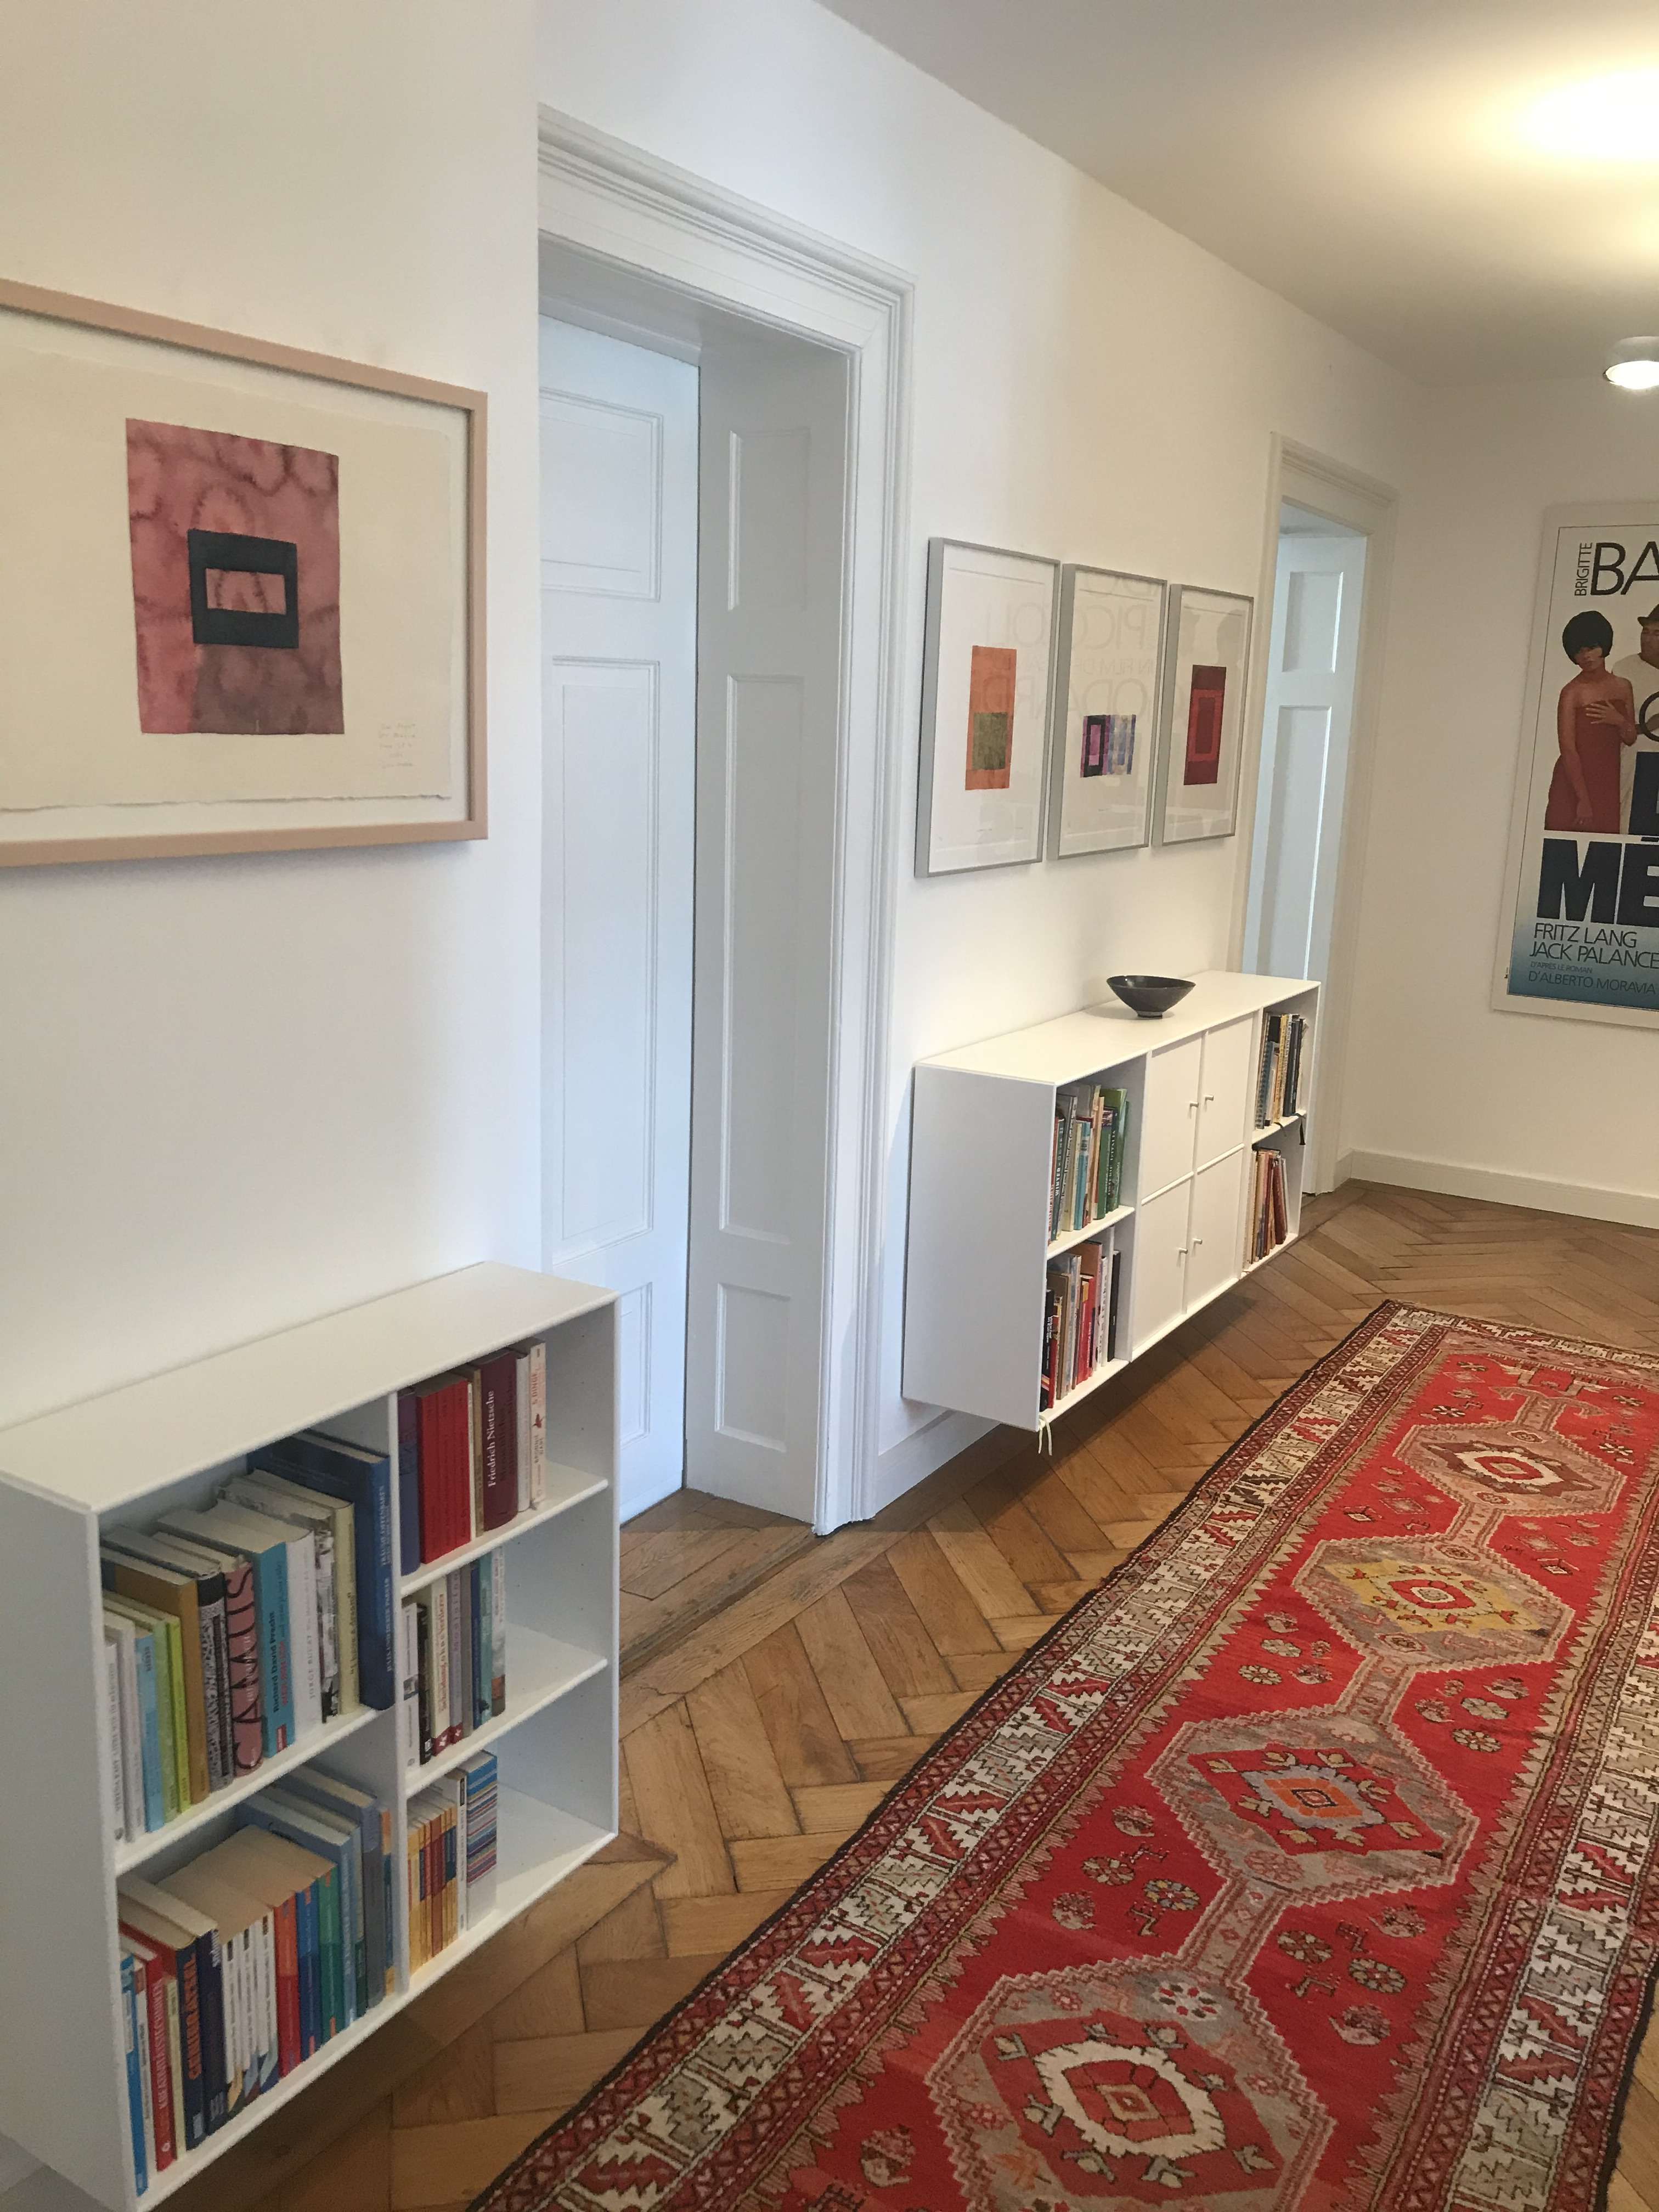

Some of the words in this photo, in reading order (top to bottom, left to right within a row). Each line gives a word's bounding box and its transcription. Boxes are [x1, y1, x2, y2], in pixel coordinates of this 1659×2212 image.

[1575, 543, 1592, 596] BRIGITTE
[1533, 923, 1580, 943] FRITZ
[1584, 929, 1637, 948] LANG
[1529, 942, 1572, 961] JACK
[1577, 946, 1659, 969] PALANCE
[1566, 966, 1593, 974] ROMAN
[1528, 970, 1593, 988] D'ALBERTO
[1596, 978, 1656, 994] MORAVIA
[487, 1391, 495, 1440] Nietzsche
[488, 1442, 496, 1487] Friedrich
[268, 1611, 276, 1643] Precht
[225, 1566, 263, 1770] CAMUS
[269, 1645, 278, 1673] David
[270, 1675, 279, 1712] Richard
